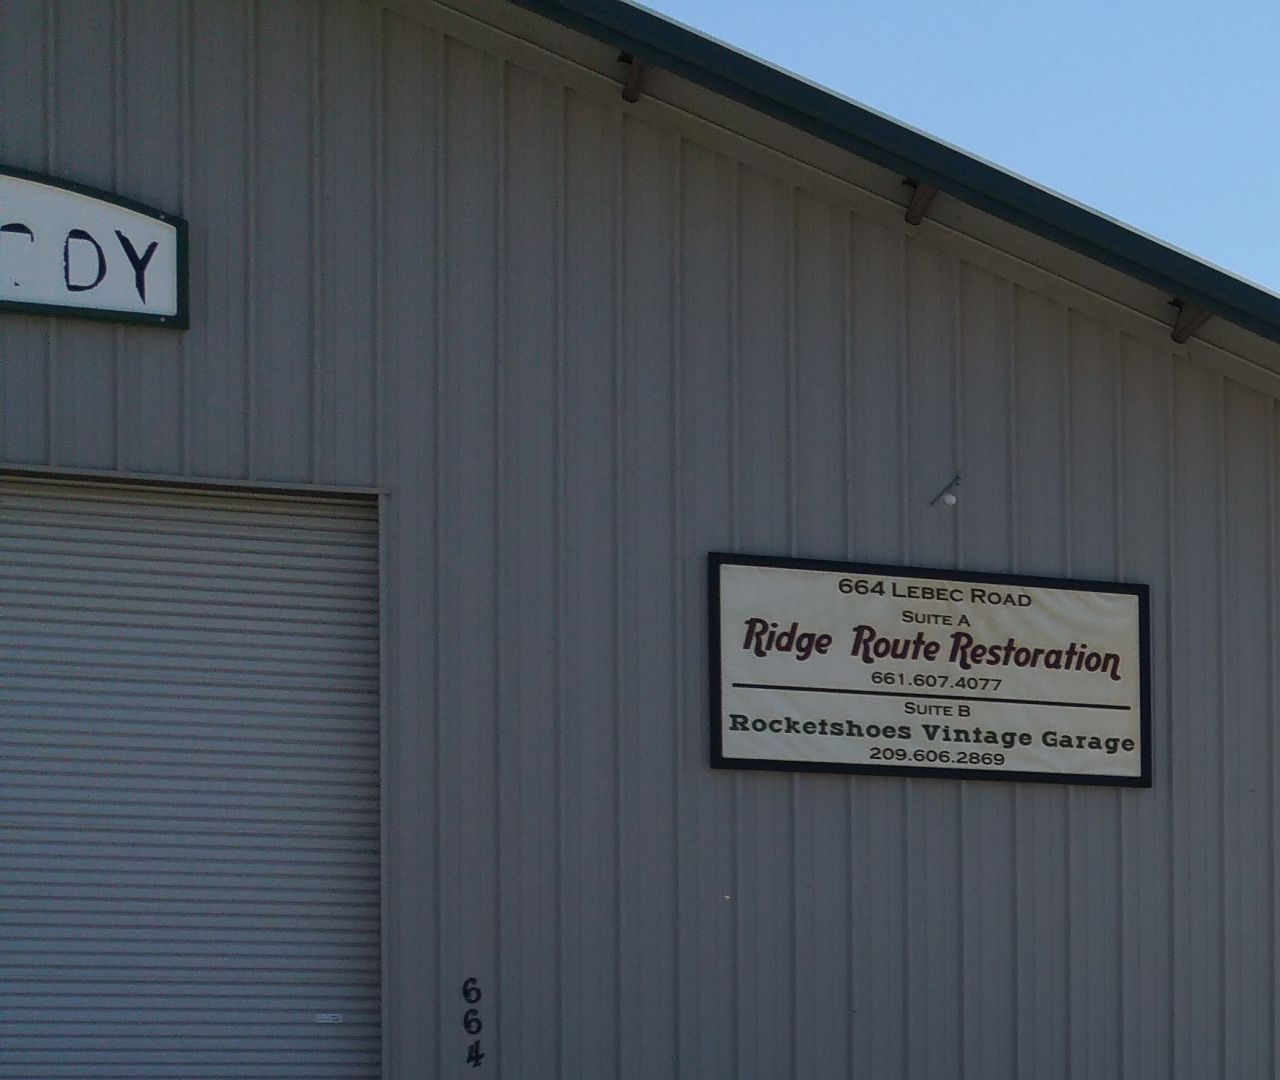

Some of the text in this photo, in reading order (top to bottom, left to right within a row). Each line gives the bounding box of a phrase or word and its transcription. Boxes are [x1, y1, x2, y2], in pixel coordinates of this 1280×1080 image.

[838, 578, 886, 597] 664
[956, 614, 971, 628] A
[742, 617, 1122, 681] Ridge Route Restoration
[871, 671, 1002, 692] 661.607.4077
[957, 705, 971, 718] B
[729, 714, 1136, 754] Rocketshoes Vintage Garage
[869, 747, 1006, 766] 209.606.2869
[462, 977, 486, 1069] 664
